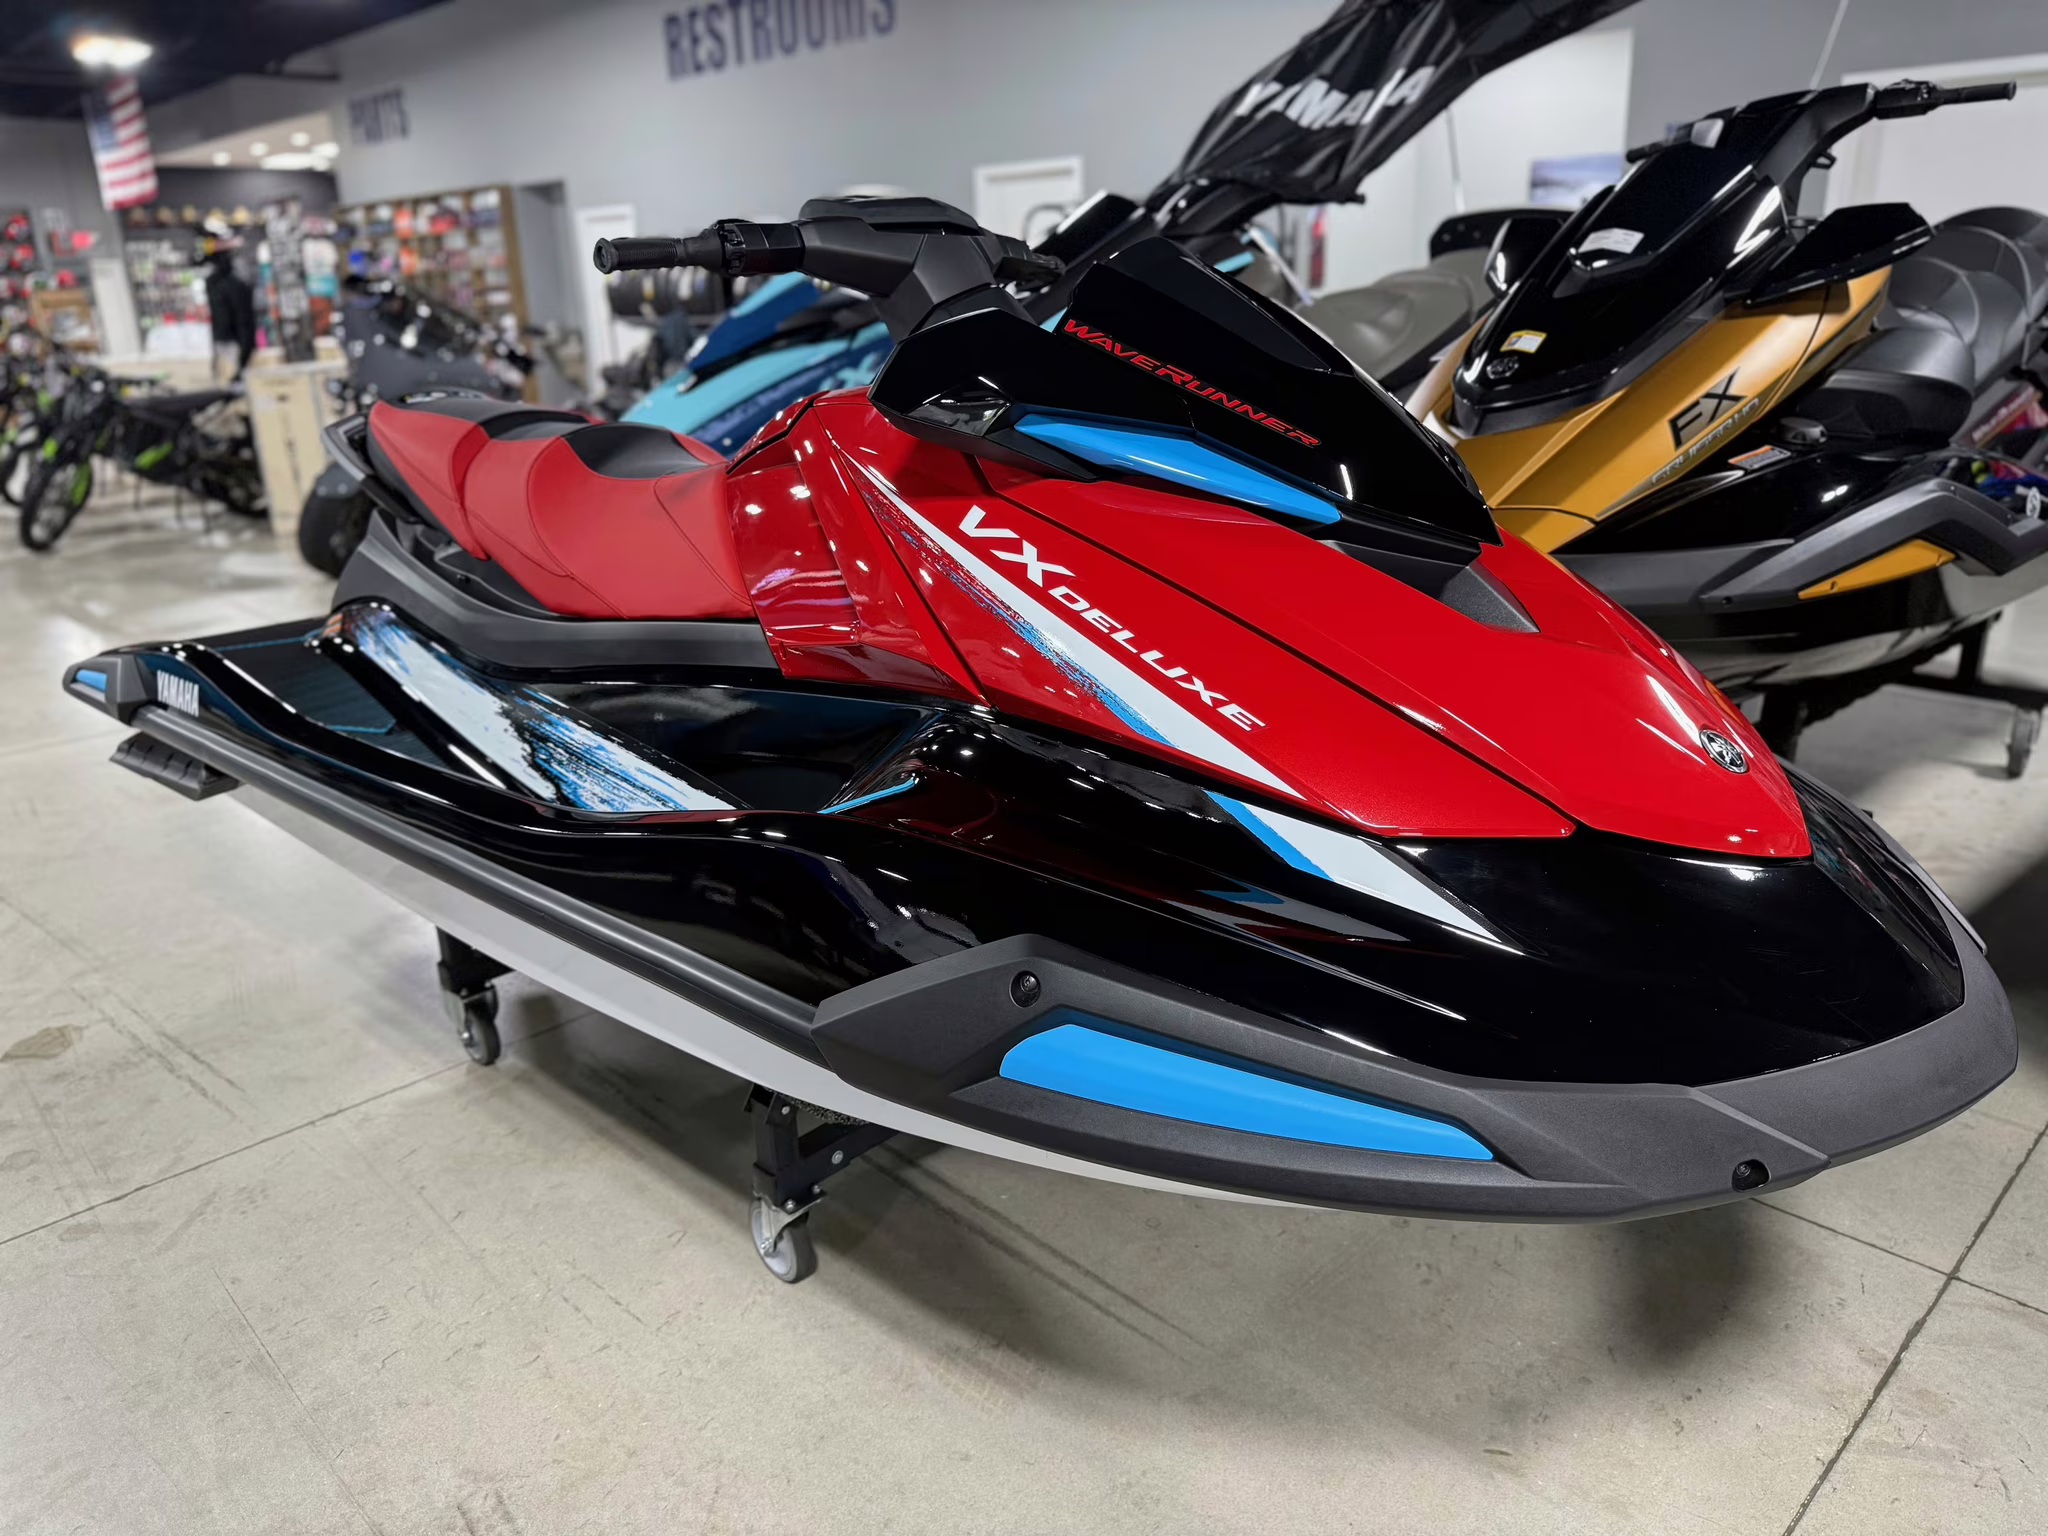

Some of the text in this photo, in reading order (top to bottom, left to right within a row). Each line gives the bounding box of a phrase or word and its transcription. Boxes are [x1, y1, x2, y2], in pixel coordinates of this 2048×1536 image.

[663, 0, 897, 81] RESTROOMS
[1063, 318, 1321, 447] WAVERUNNER
[1667, 368, 1748, 452] FX
[958, 504, 1267, 732] VX DELUXE
[156, 669, 200, 718] YAMAHA
